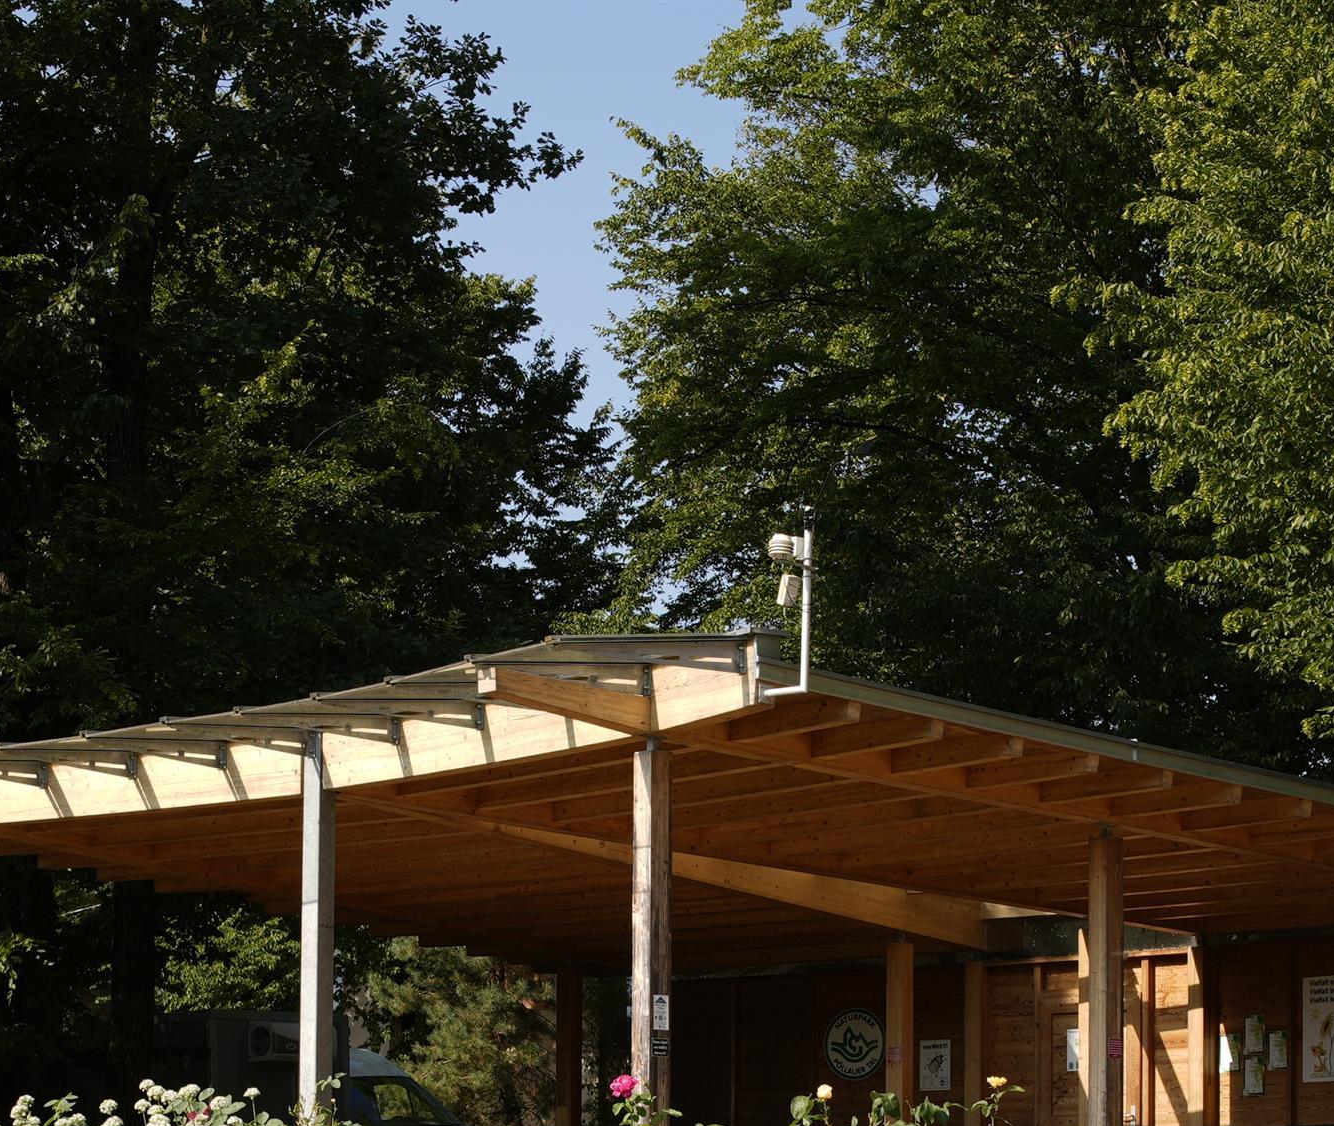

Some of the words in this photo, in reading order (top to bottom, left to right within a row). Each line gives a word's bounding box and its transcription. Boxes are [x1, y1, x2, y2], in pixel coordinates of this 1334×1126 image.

[835, 1013, 876, 1030] NATURPARK
[833, 1057, 866, 1075] PÖLLAUER
[865, 1057, 877, 1071] TAL
